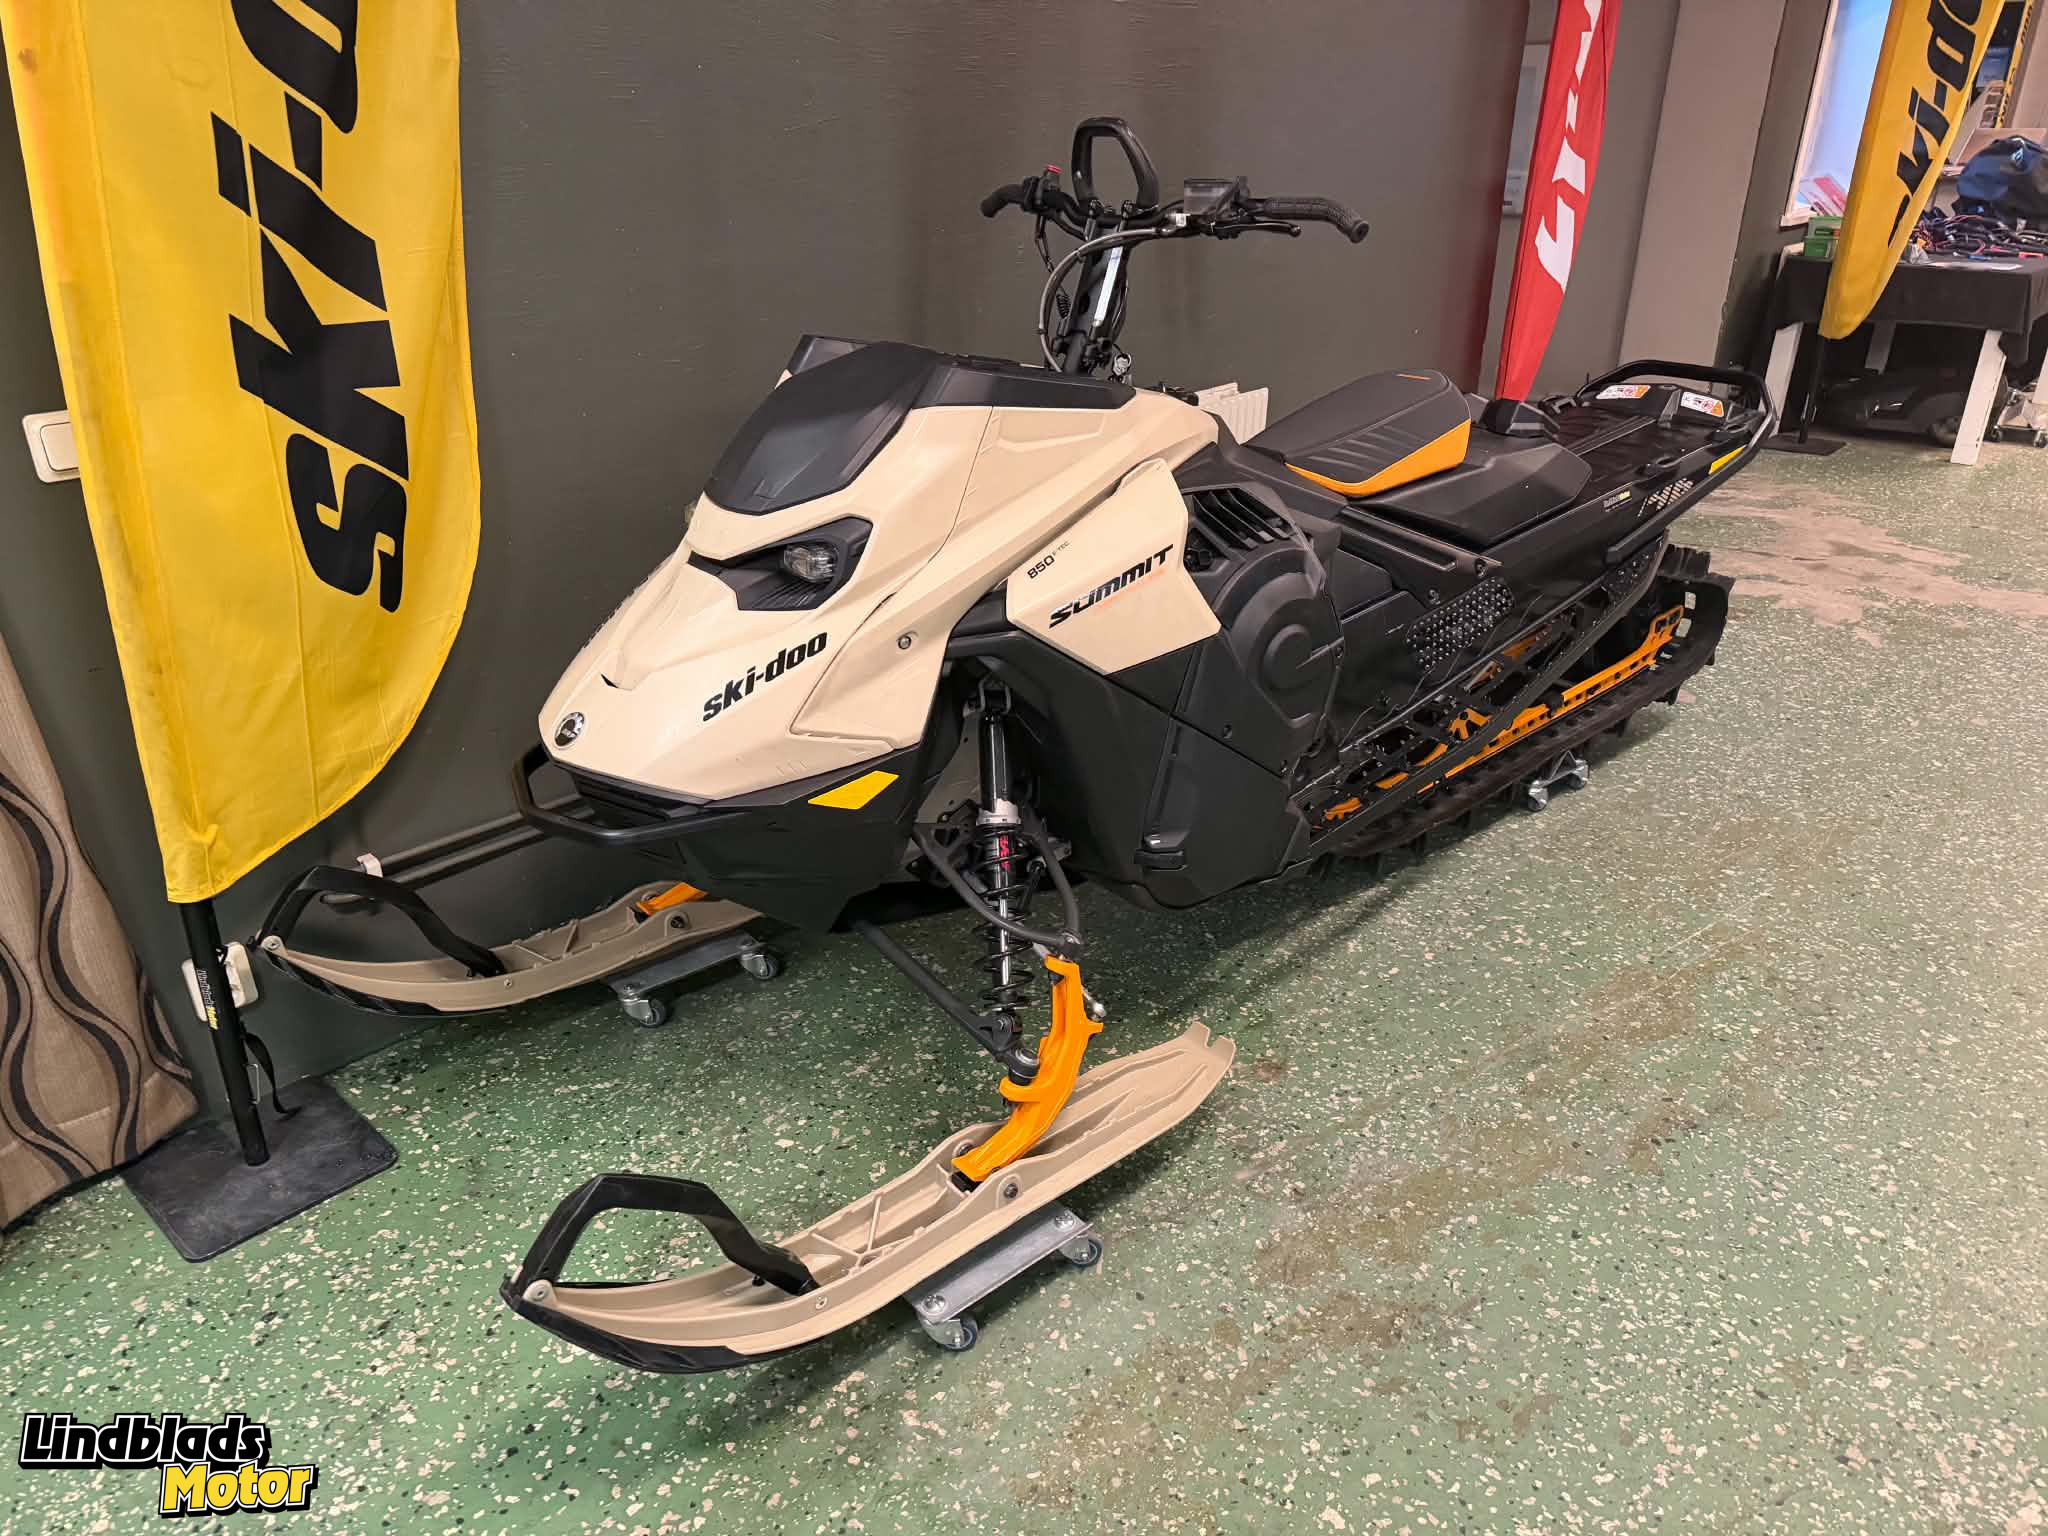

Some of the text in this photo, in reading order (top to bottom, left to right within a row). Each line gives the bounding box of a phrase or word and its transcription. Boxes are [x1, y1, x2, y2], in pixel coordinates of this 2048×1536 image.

[1027, 554, 1056, 580] 850
[1048, 543, 1174, 629] SUMMIT
[702, 631, 828, 722] ski-doo
